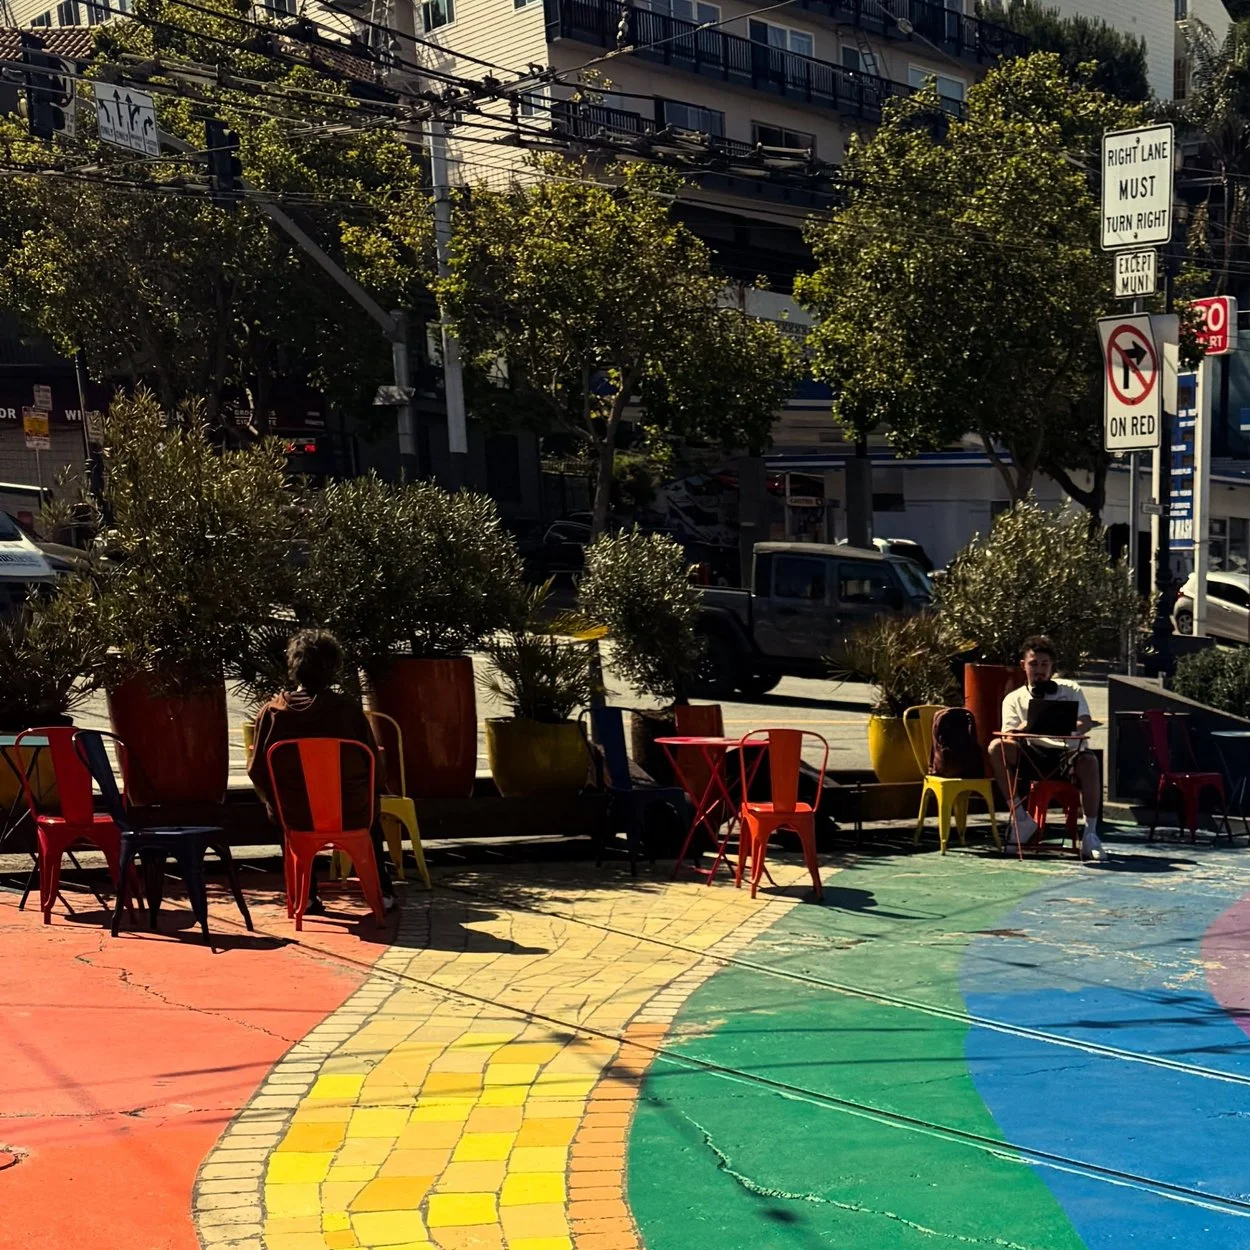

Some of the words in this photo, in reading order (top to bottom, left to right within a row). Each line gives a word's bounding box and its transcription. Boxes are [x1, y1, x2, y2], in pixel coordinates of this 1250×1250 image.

[1107, 145, 1138, 167] RIGHT
[1141, 141, 1168, 162] LANE
[1119, 175, 1156, 201] MUST
[1106, 214, 1133, 233] TURN
[1136, 209, 1167, 230] RIGHT
[1119, 254, 1152, 275] EXCEPT
[1122, 274, 1149, 293] MUNI
[1110, 417, 1127, 437] ON
[1132, 415, 1155, 436] RED
